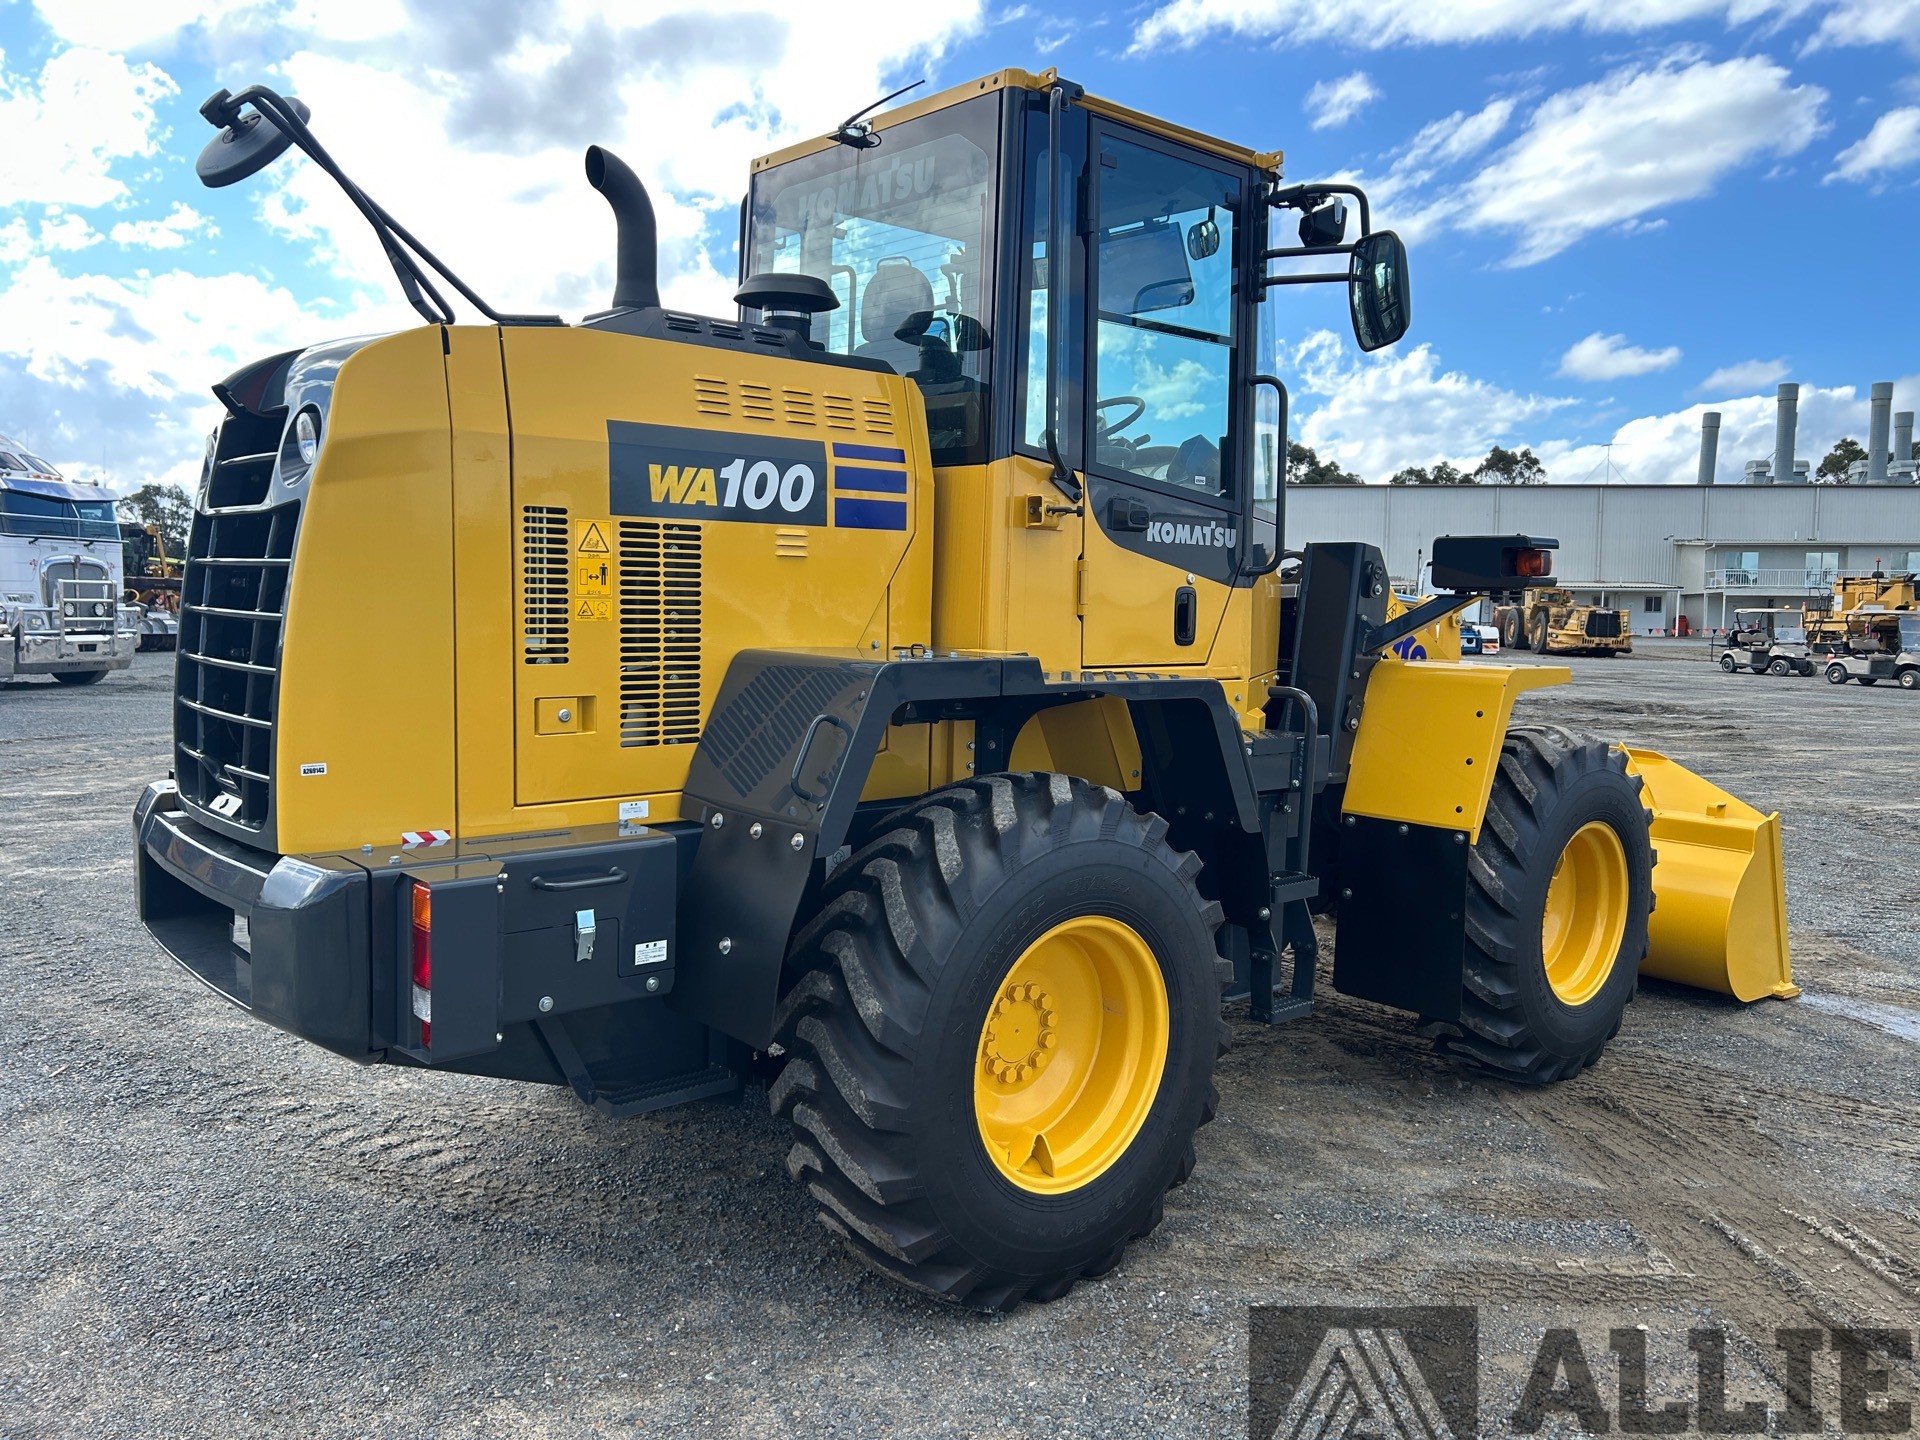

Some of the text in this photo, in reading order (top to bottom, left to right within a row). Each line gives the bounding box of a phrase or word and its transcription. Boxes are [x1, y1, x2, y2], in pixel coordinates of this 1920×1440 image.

[799, 156, 936, 222] KOMATSU
[648, 458, 815, 513] WA100
[1146, 521, 1237, 549] KOMATSU
